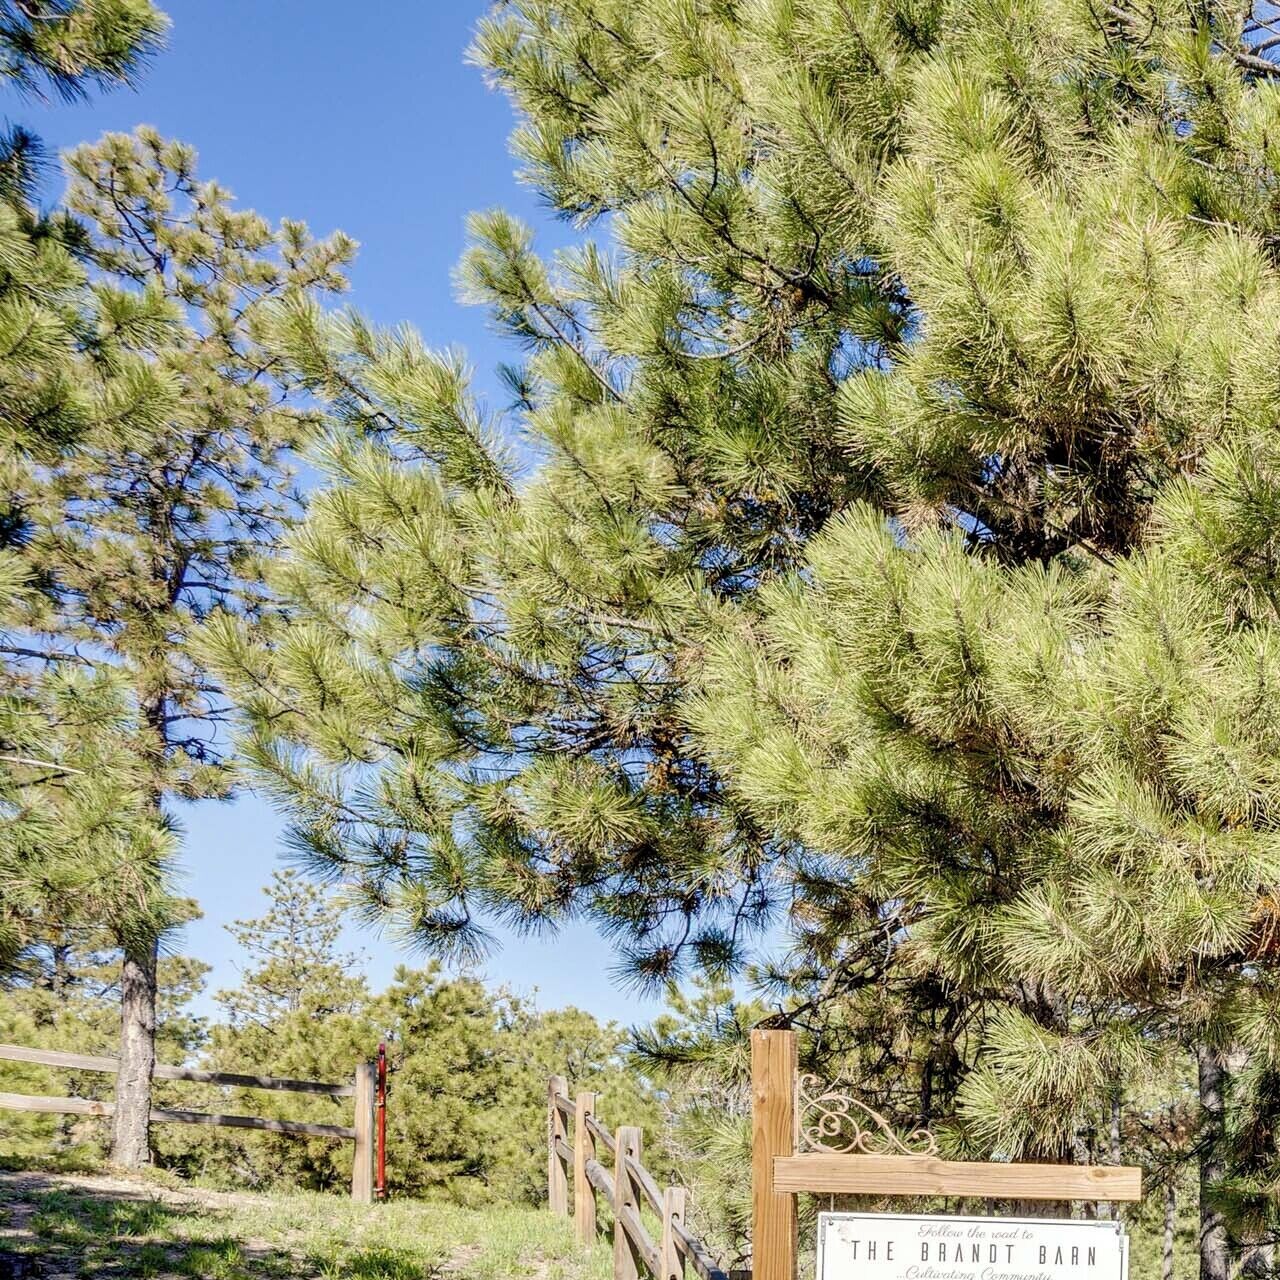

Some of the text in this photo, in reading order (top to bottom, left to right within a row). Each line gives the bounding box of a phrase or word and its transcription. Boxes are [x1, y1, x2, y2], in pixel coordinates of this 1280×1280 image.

[917, 1224, 1034, 1240] Follow the road to
[851, 1240, 1097, 1266] THE BRANDT BARN
